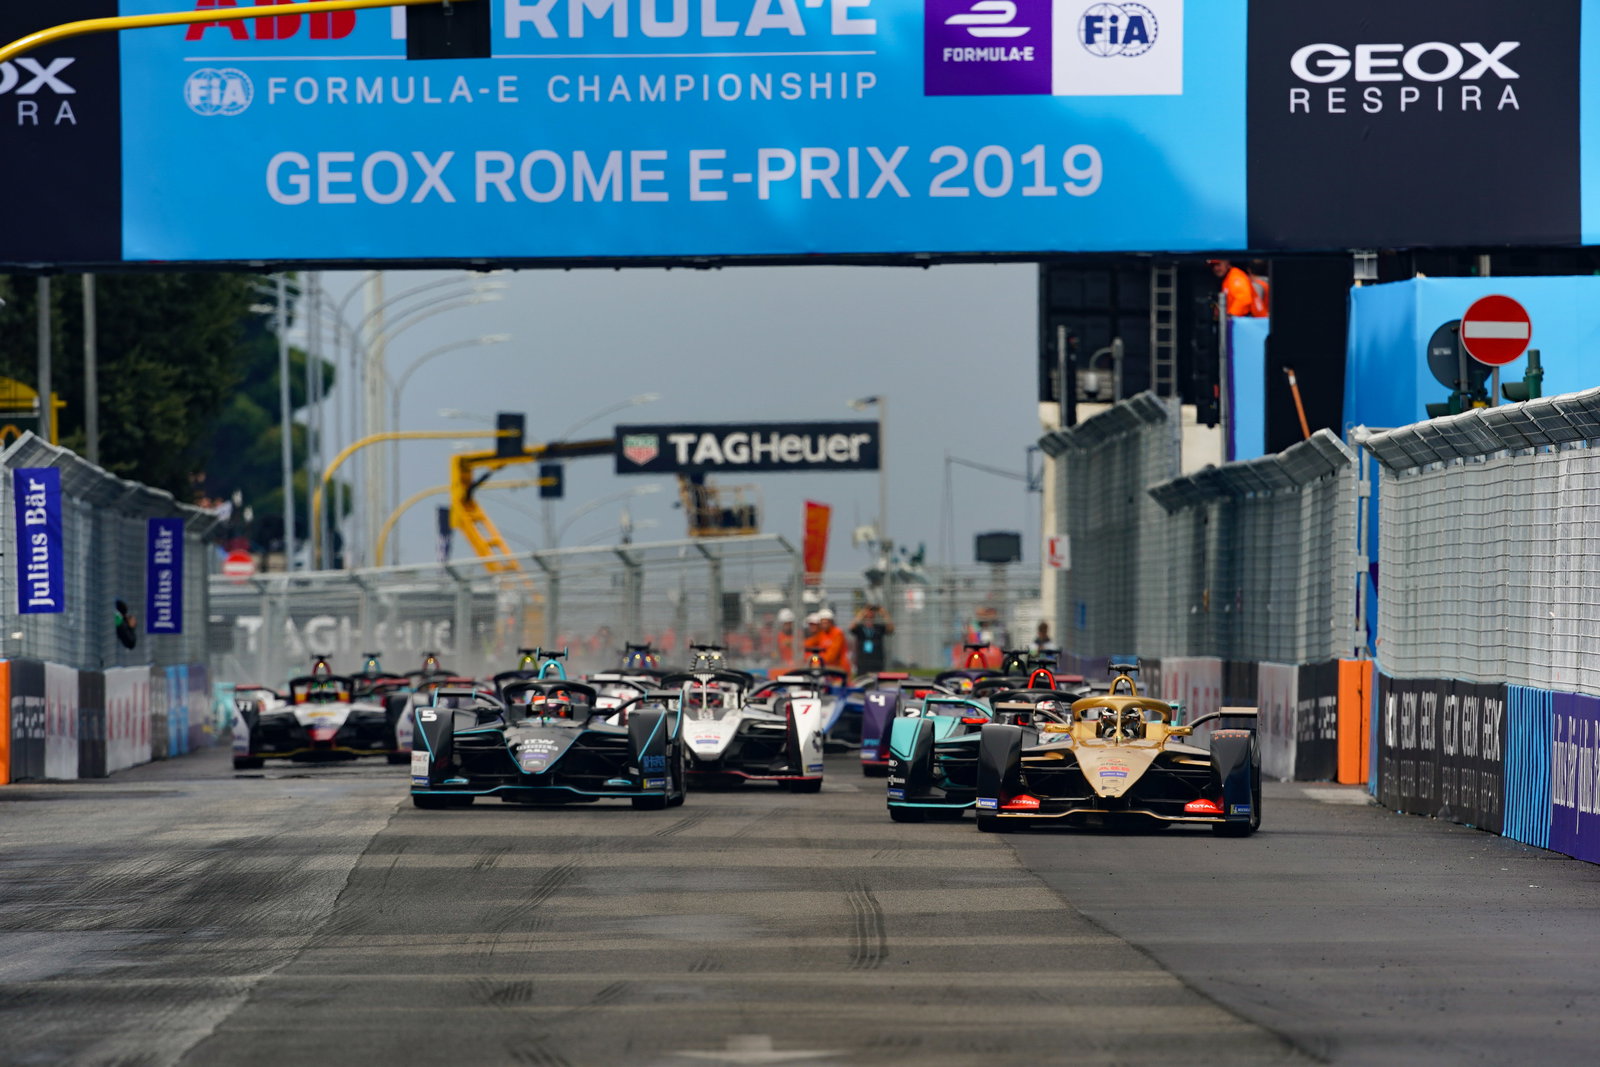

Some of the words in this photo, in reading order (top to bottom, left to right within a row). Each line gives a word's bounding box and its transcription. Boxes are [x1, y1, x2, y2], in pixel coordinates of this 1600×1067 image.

[1290, 41, 1521, 83] GEOX
[267, 76, 518, 105] FORMULA-E
[547, 71, 878, 103] CHAMPIONSHIP
[1289, 84, 1521, 113] RESPIRA
[266, 150, 456, 204] GEOX
[475, 150, 669, 203] ROME
[689, 147, 911, 202] E-PRIX
[929, 144, 1103, 198] 2019
[25, 478, 48, 527] Bär
[28, 533, 55, 607] Julius
[153, 569, 175, 629] Julius
[421, 710, 437, 722] 5
[800, 704, 812, 715] 7
[869, 694, 885, 707] 4
